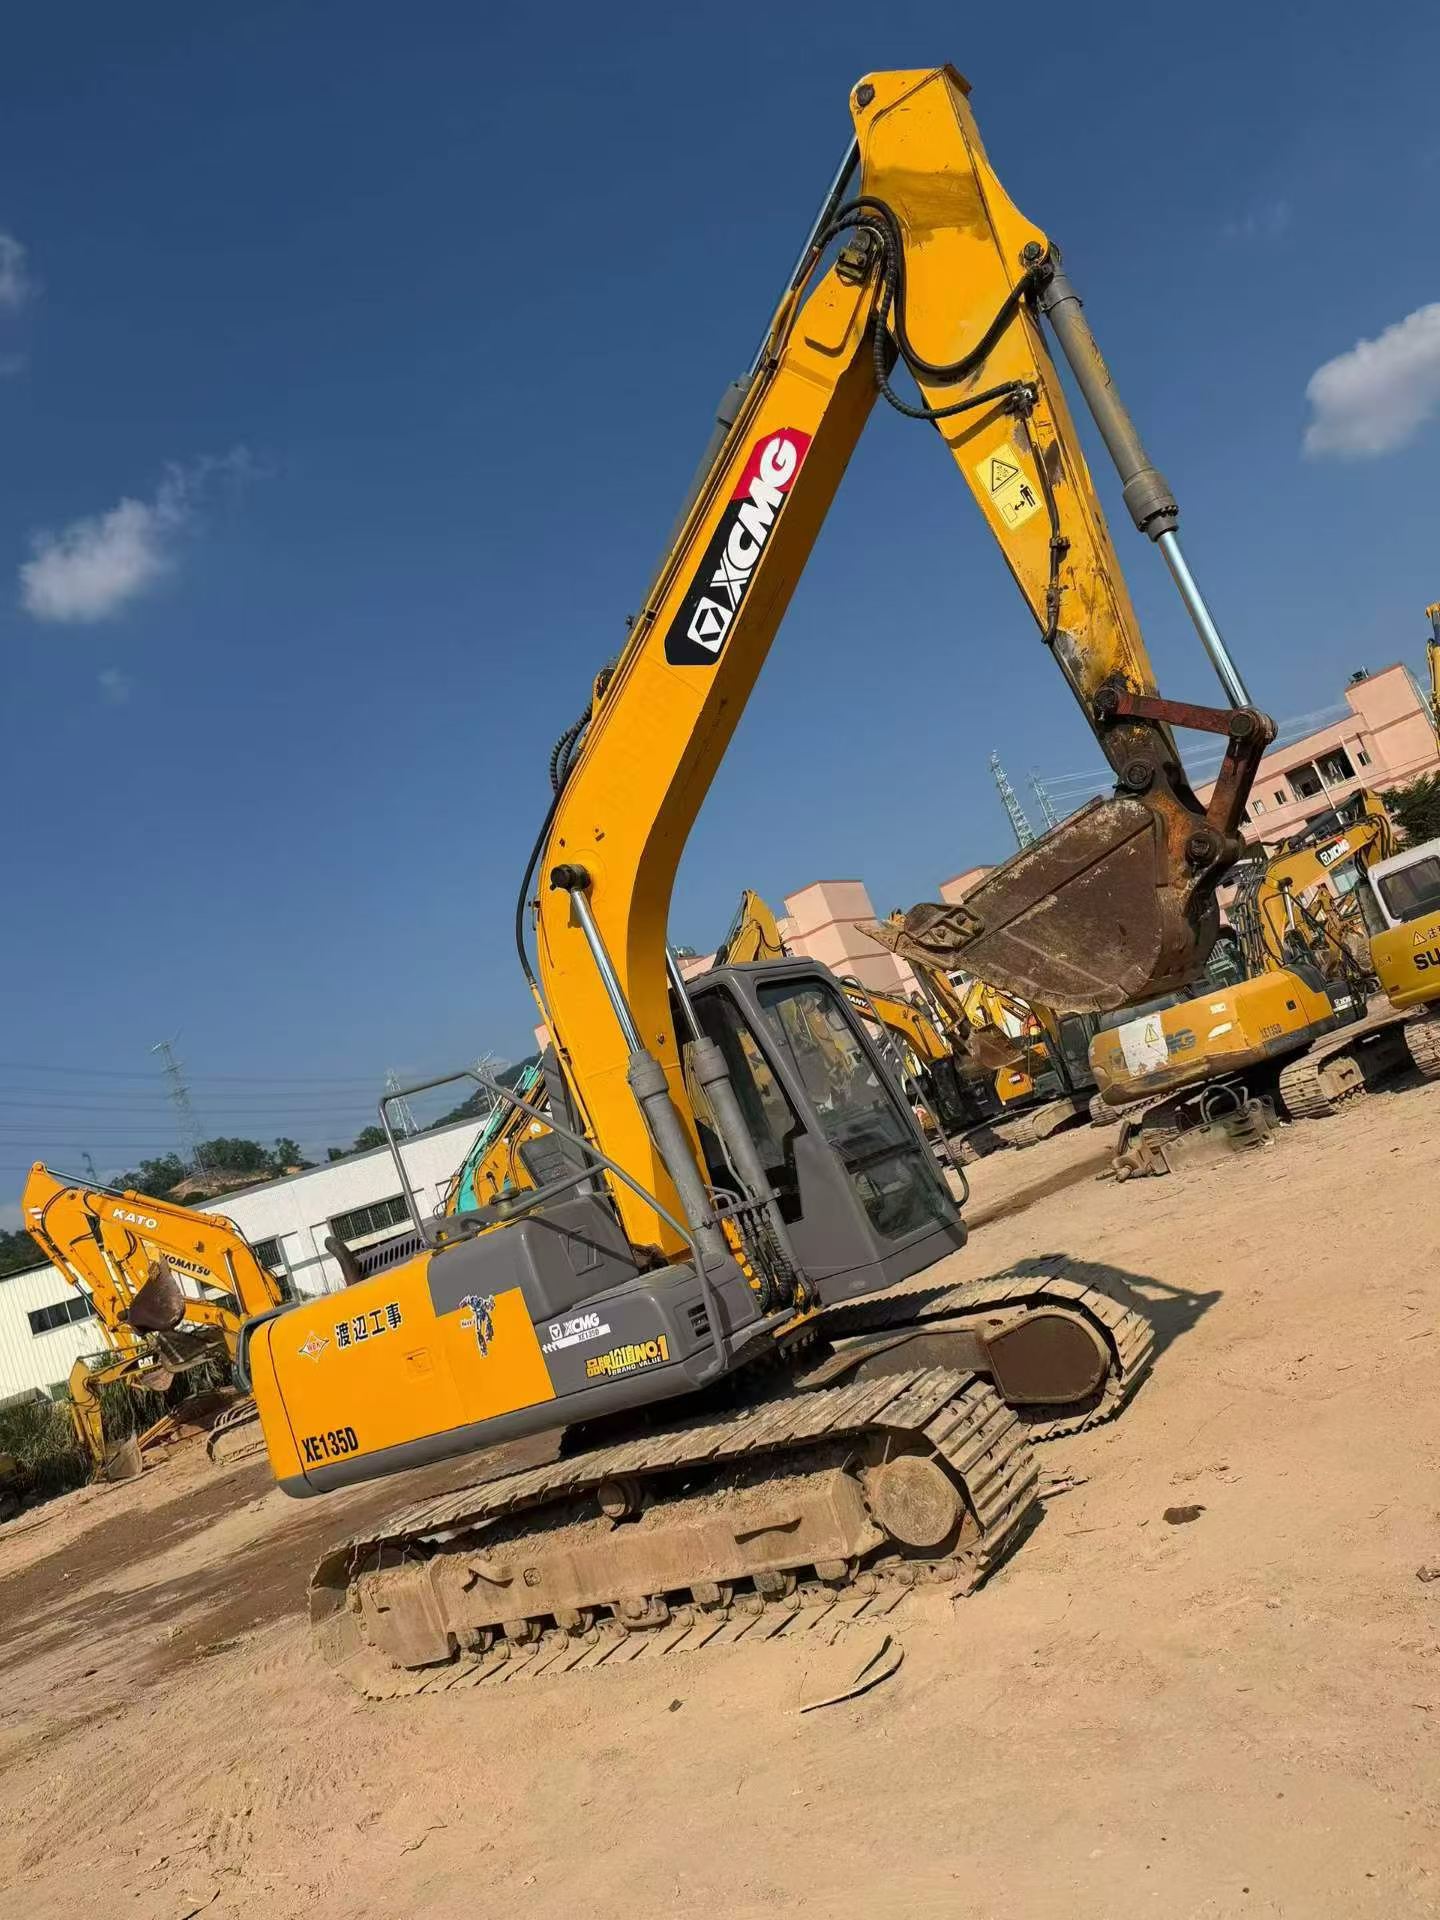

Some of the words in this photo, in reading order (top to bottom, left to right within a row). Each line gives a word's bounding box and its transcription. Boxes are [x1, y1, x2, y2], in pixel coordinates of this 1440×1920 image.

[710, 437, 798, 612] XCMG
[112, 1208, 158, 1229] KATO
[563, 1312, 600, 1337] XCMG
[138, 1355, 154, 1369] CAT
[301, 1426, 359, 1463] XE135D
